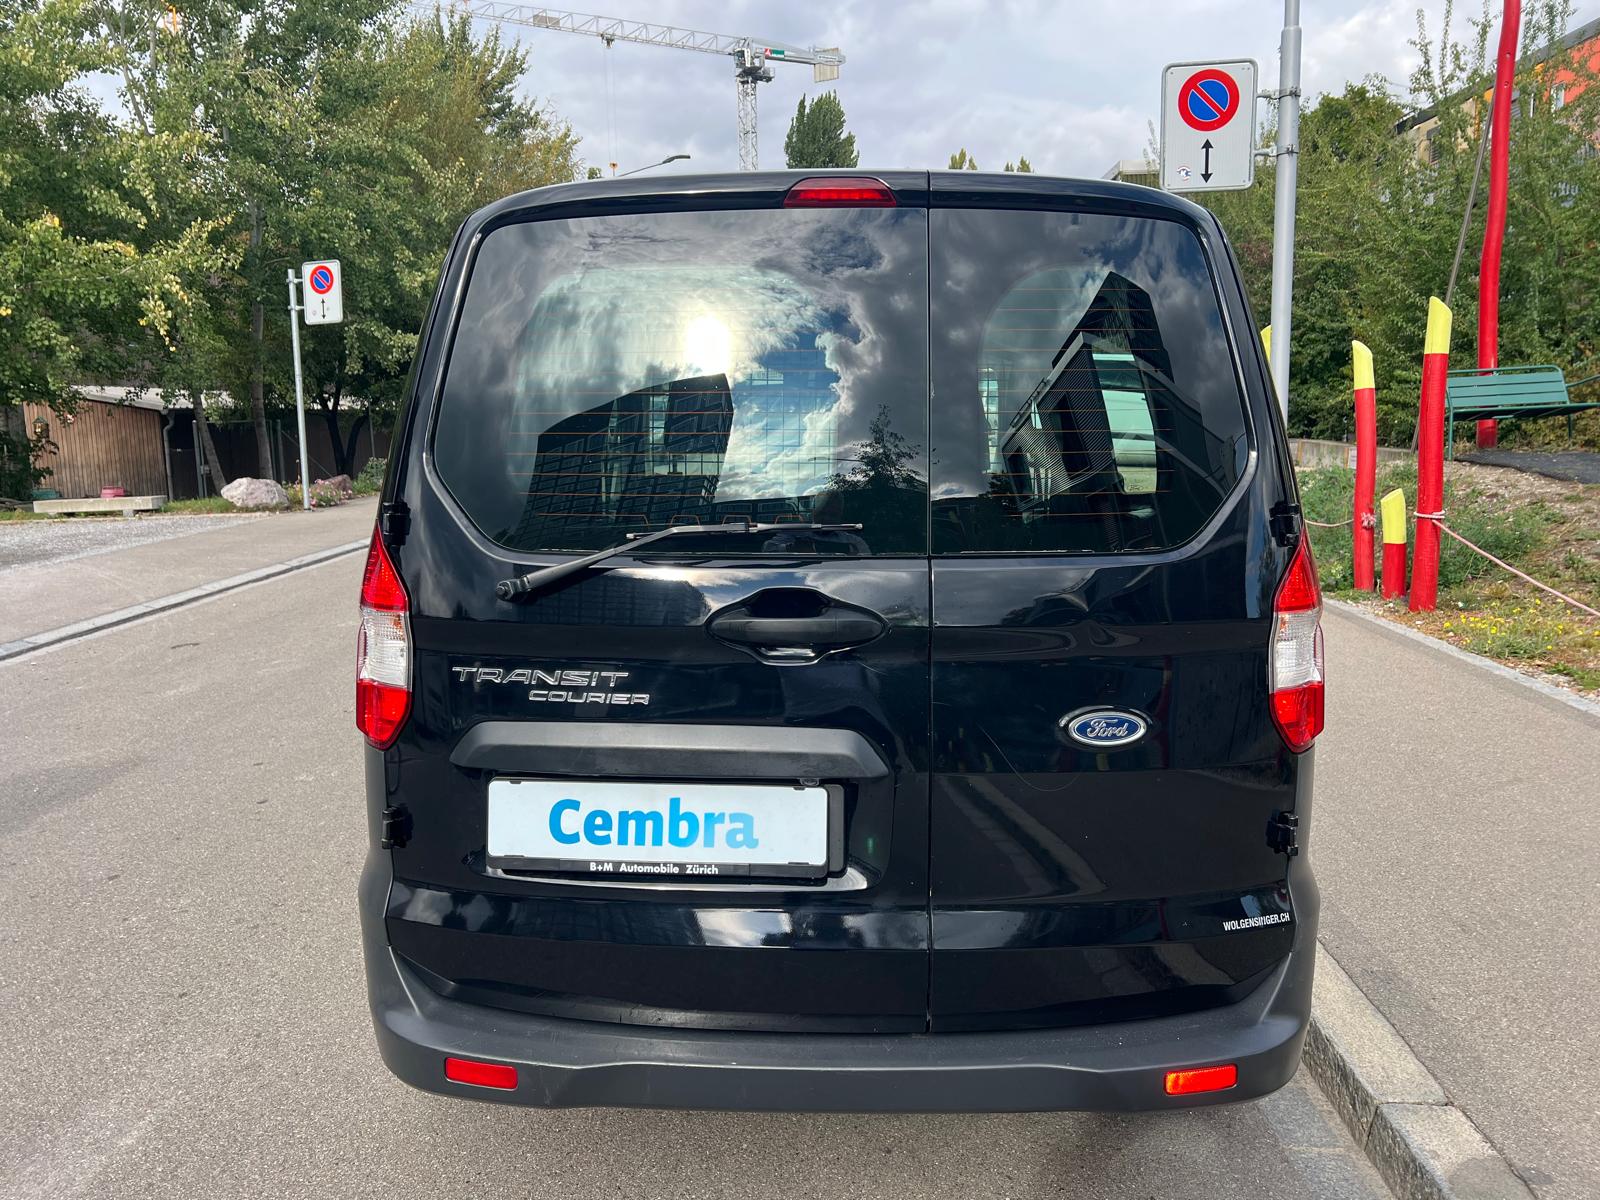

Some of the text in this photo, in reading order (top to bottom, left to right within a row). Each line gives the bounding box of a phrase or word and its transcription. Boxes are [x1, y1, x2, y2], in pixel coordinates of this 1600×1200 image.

[452, 666, 629, 687] TRANSIT
[528, 690, 650, 705] COURIER
[1087, 718, 1129, 737] Ford
[548, 797, 759, 849] Cembra
[589, 862, 719, 875] B+M Automobile Zürich
[1222, 912, 1290, 931] WOLGENSINGER.CH
